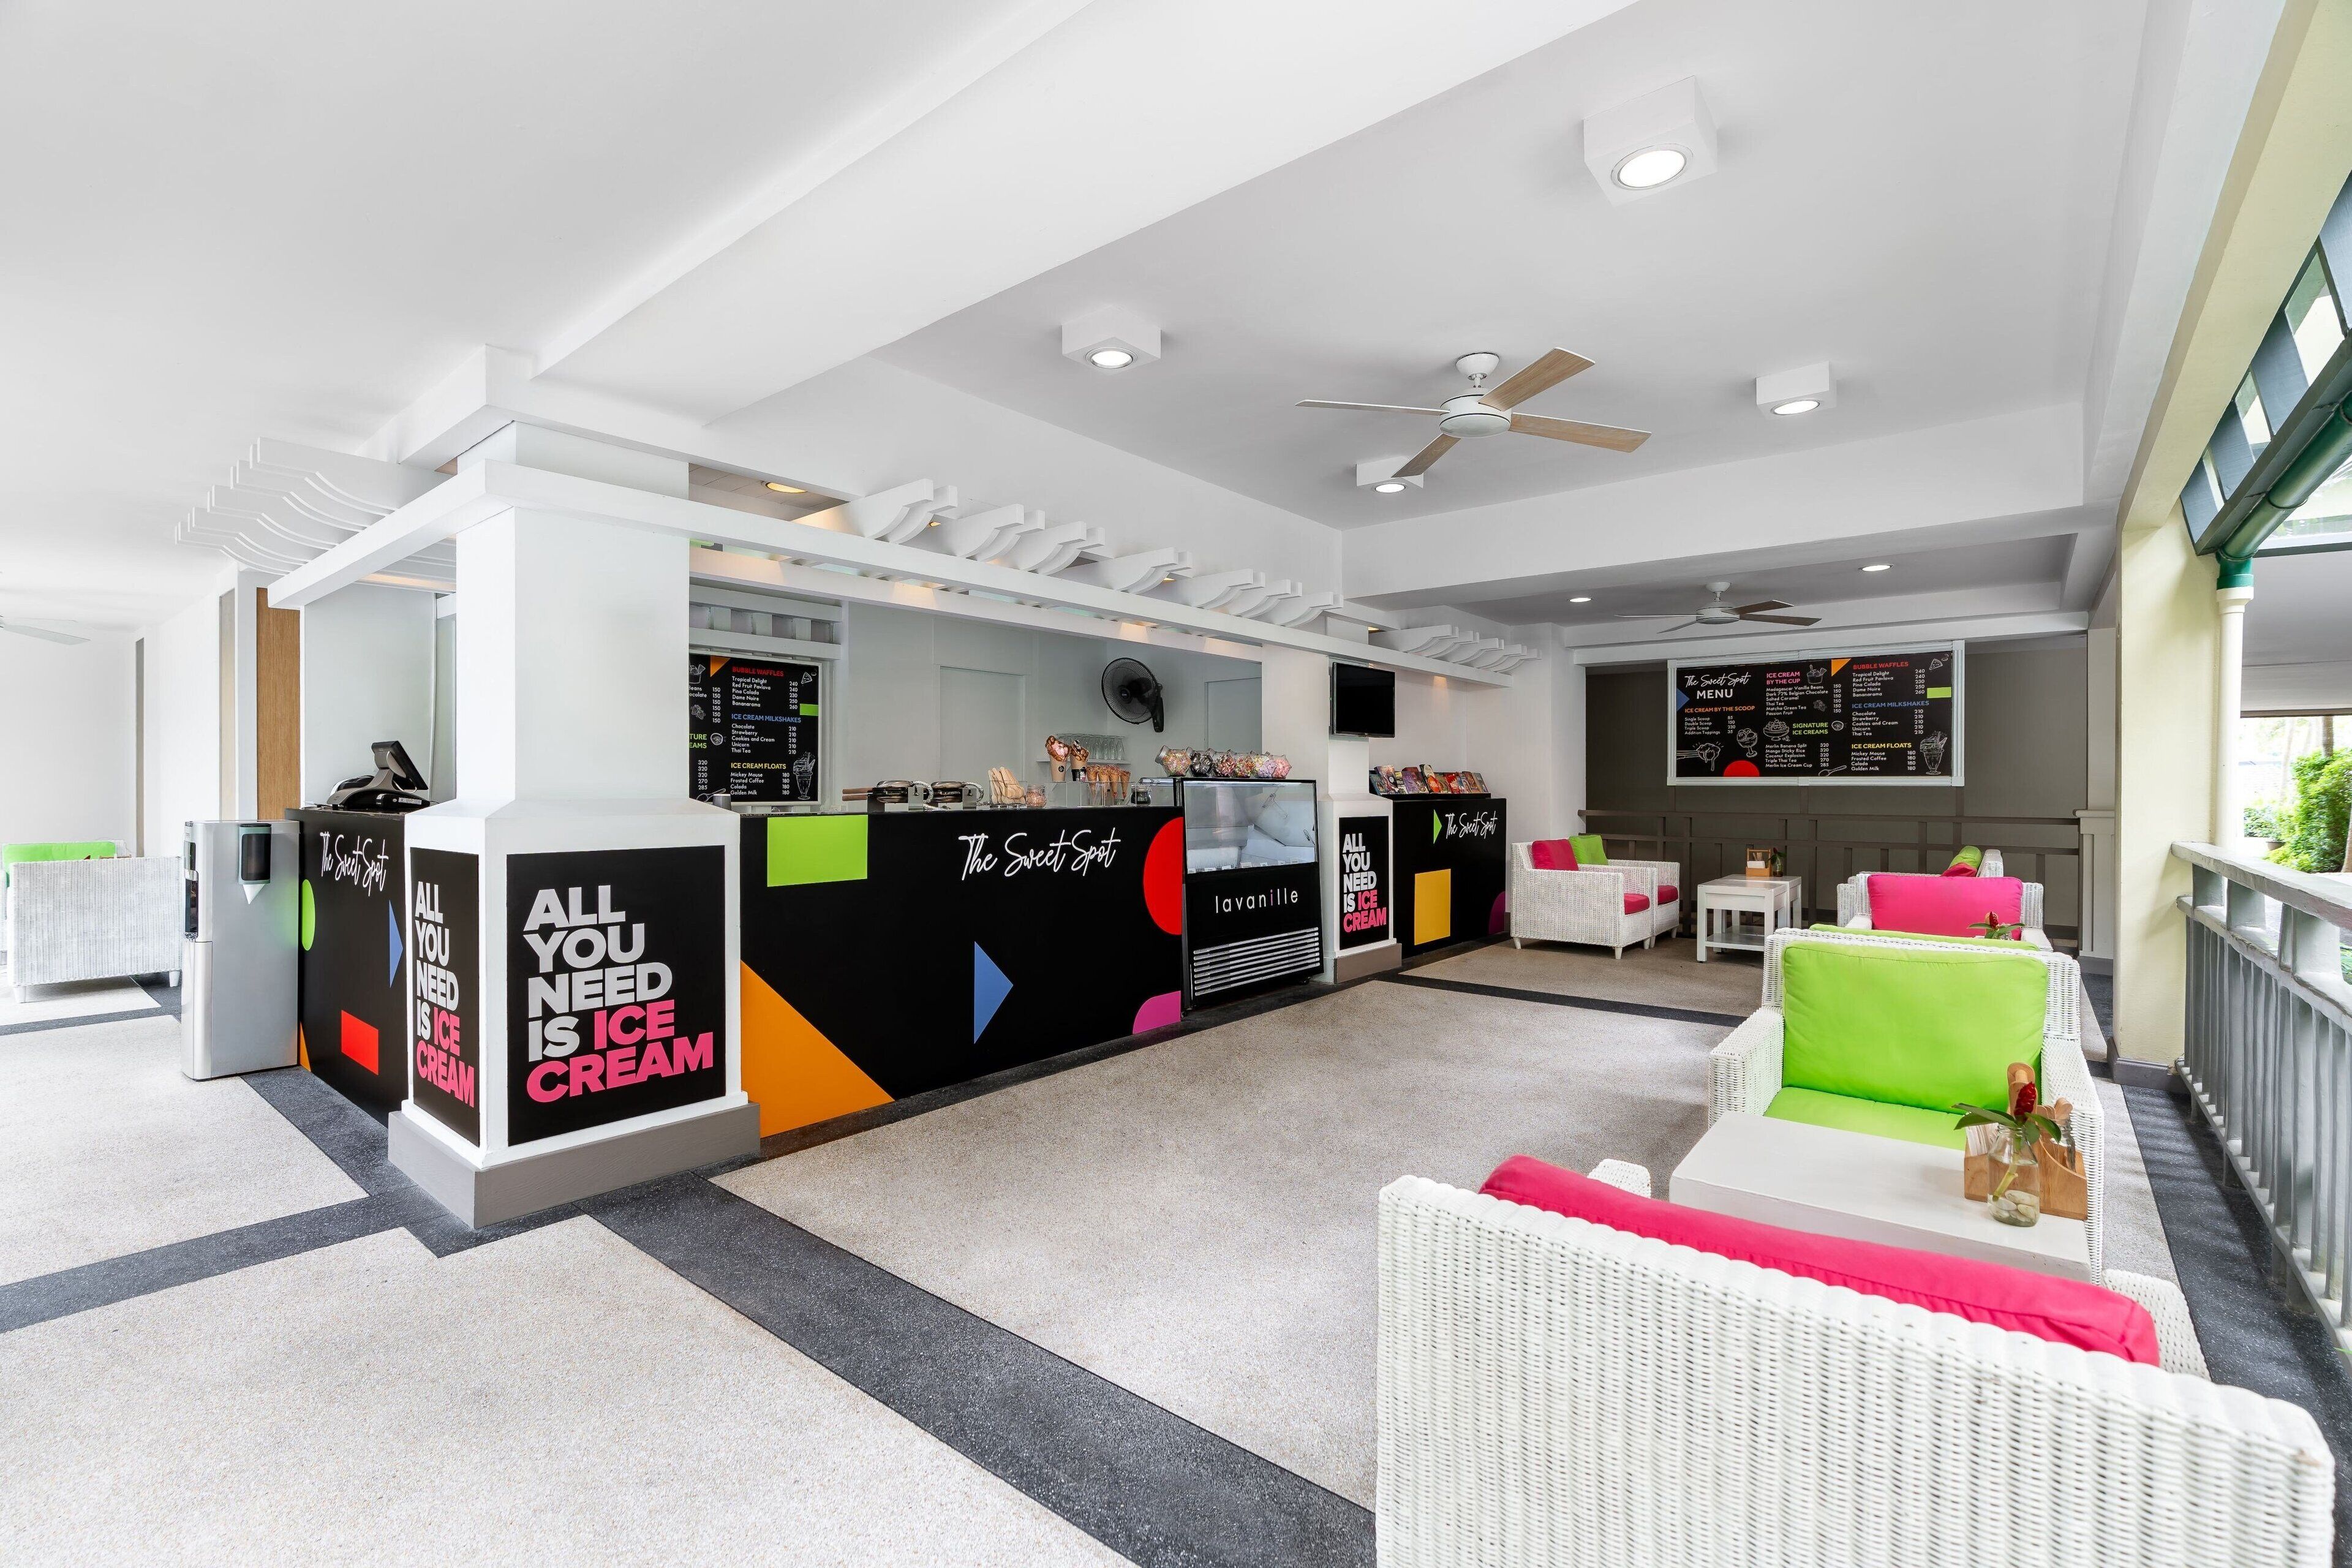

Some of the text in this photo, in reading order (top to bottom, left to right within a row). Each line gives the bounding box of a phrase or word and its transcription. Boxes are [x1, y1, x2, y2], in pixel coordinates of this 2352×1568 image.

[1684, 672, 1751, 687] The Sweet Spot
[1697, 689, 1733, 699] MENU
[1343, 833, 1366, 853] ALL
[1446, 811, 1498, 839] The Sweet Spot
[319, 831, 389, 897] The Sweet Spot
[958, 827, 1121, 881] The Sweet Spot
[1343, 852, 1370, 872] YOU
[415, 881, 443, 924] ALL
[1215, 888, 1298, 913] lavanille
[1344, 871, 1377, 893] NEED
[1344, 889, 1378, 913] IS ICE
[523, 885, 625, 932] ALL
[1343, 907, 1387, 933] CREAM
[415, 920, 450, 967] YOU
[524, 923, 645, 974] YOU
[417, 959, 459, 1011] NEED
[528, 962, 673, 1019] NEED
[417, 1000, 459, 1057] IS ICE
[529, 999, 676, 1063] IS ICE
[417, 1039, 474, 1108] CREAM
[526, 1031, 714, 1104] CREAM
